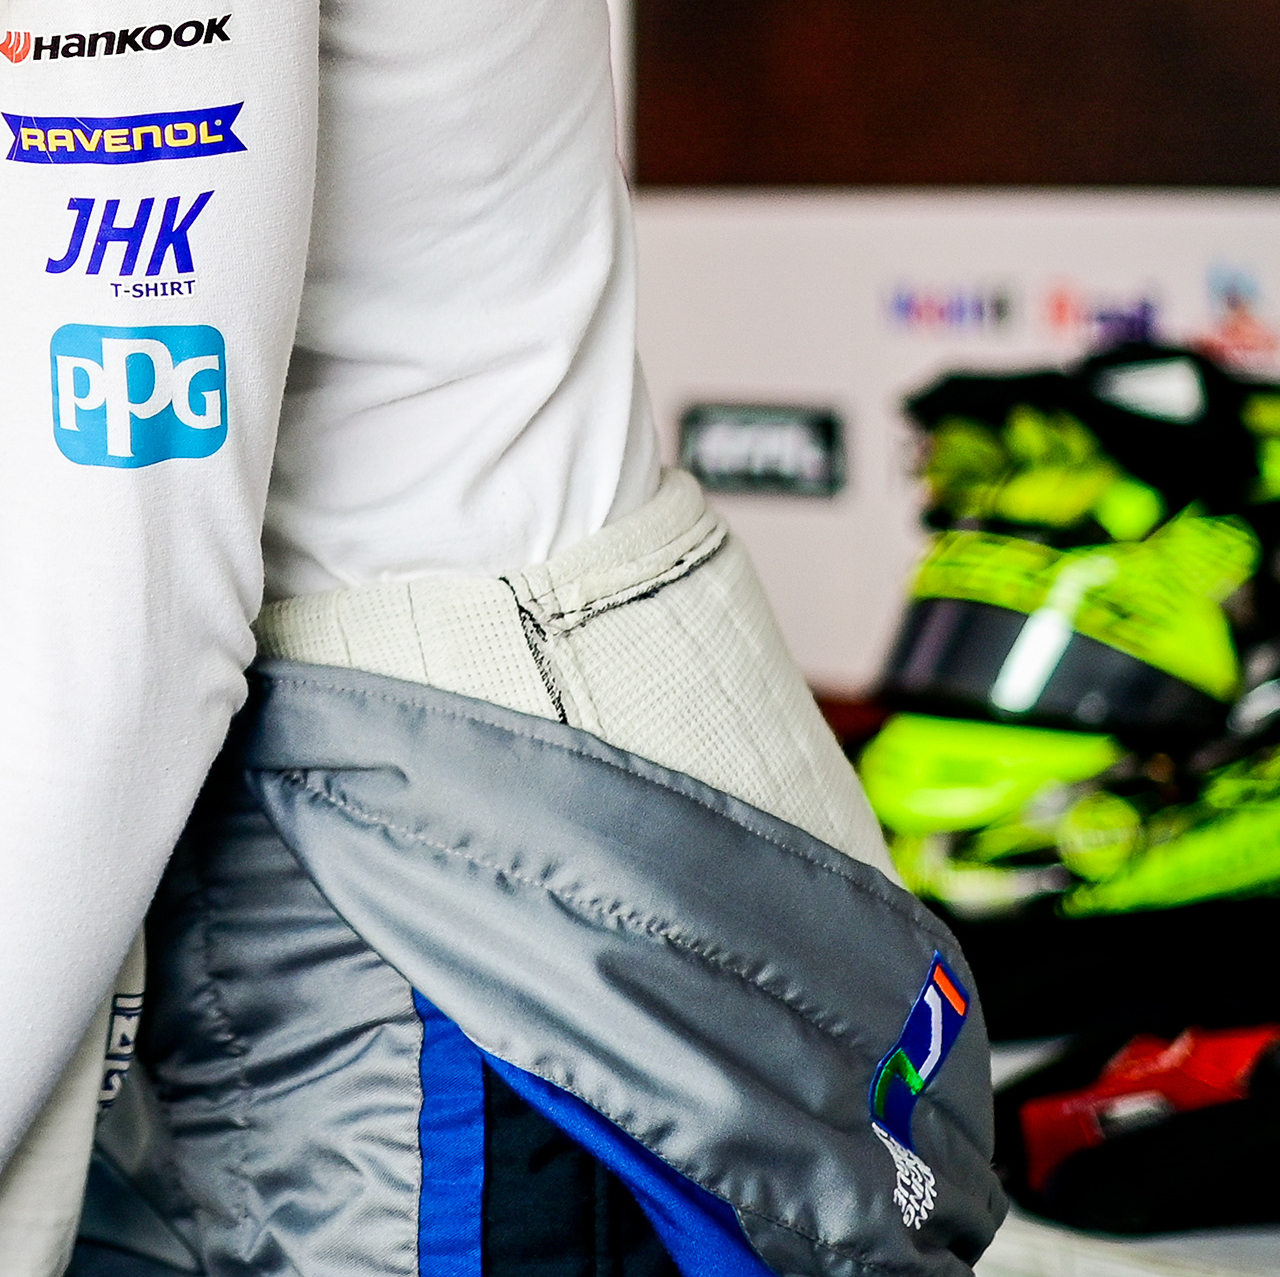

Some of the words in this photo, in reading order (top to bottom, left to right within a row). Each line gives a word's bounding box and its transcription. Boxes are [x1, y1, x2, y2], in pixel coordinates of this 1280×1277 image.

[45, 189, 215, 277] JHK
[110, 279, 197, 299] T-SHIRT
[56, 337, 222, 458] PPG
